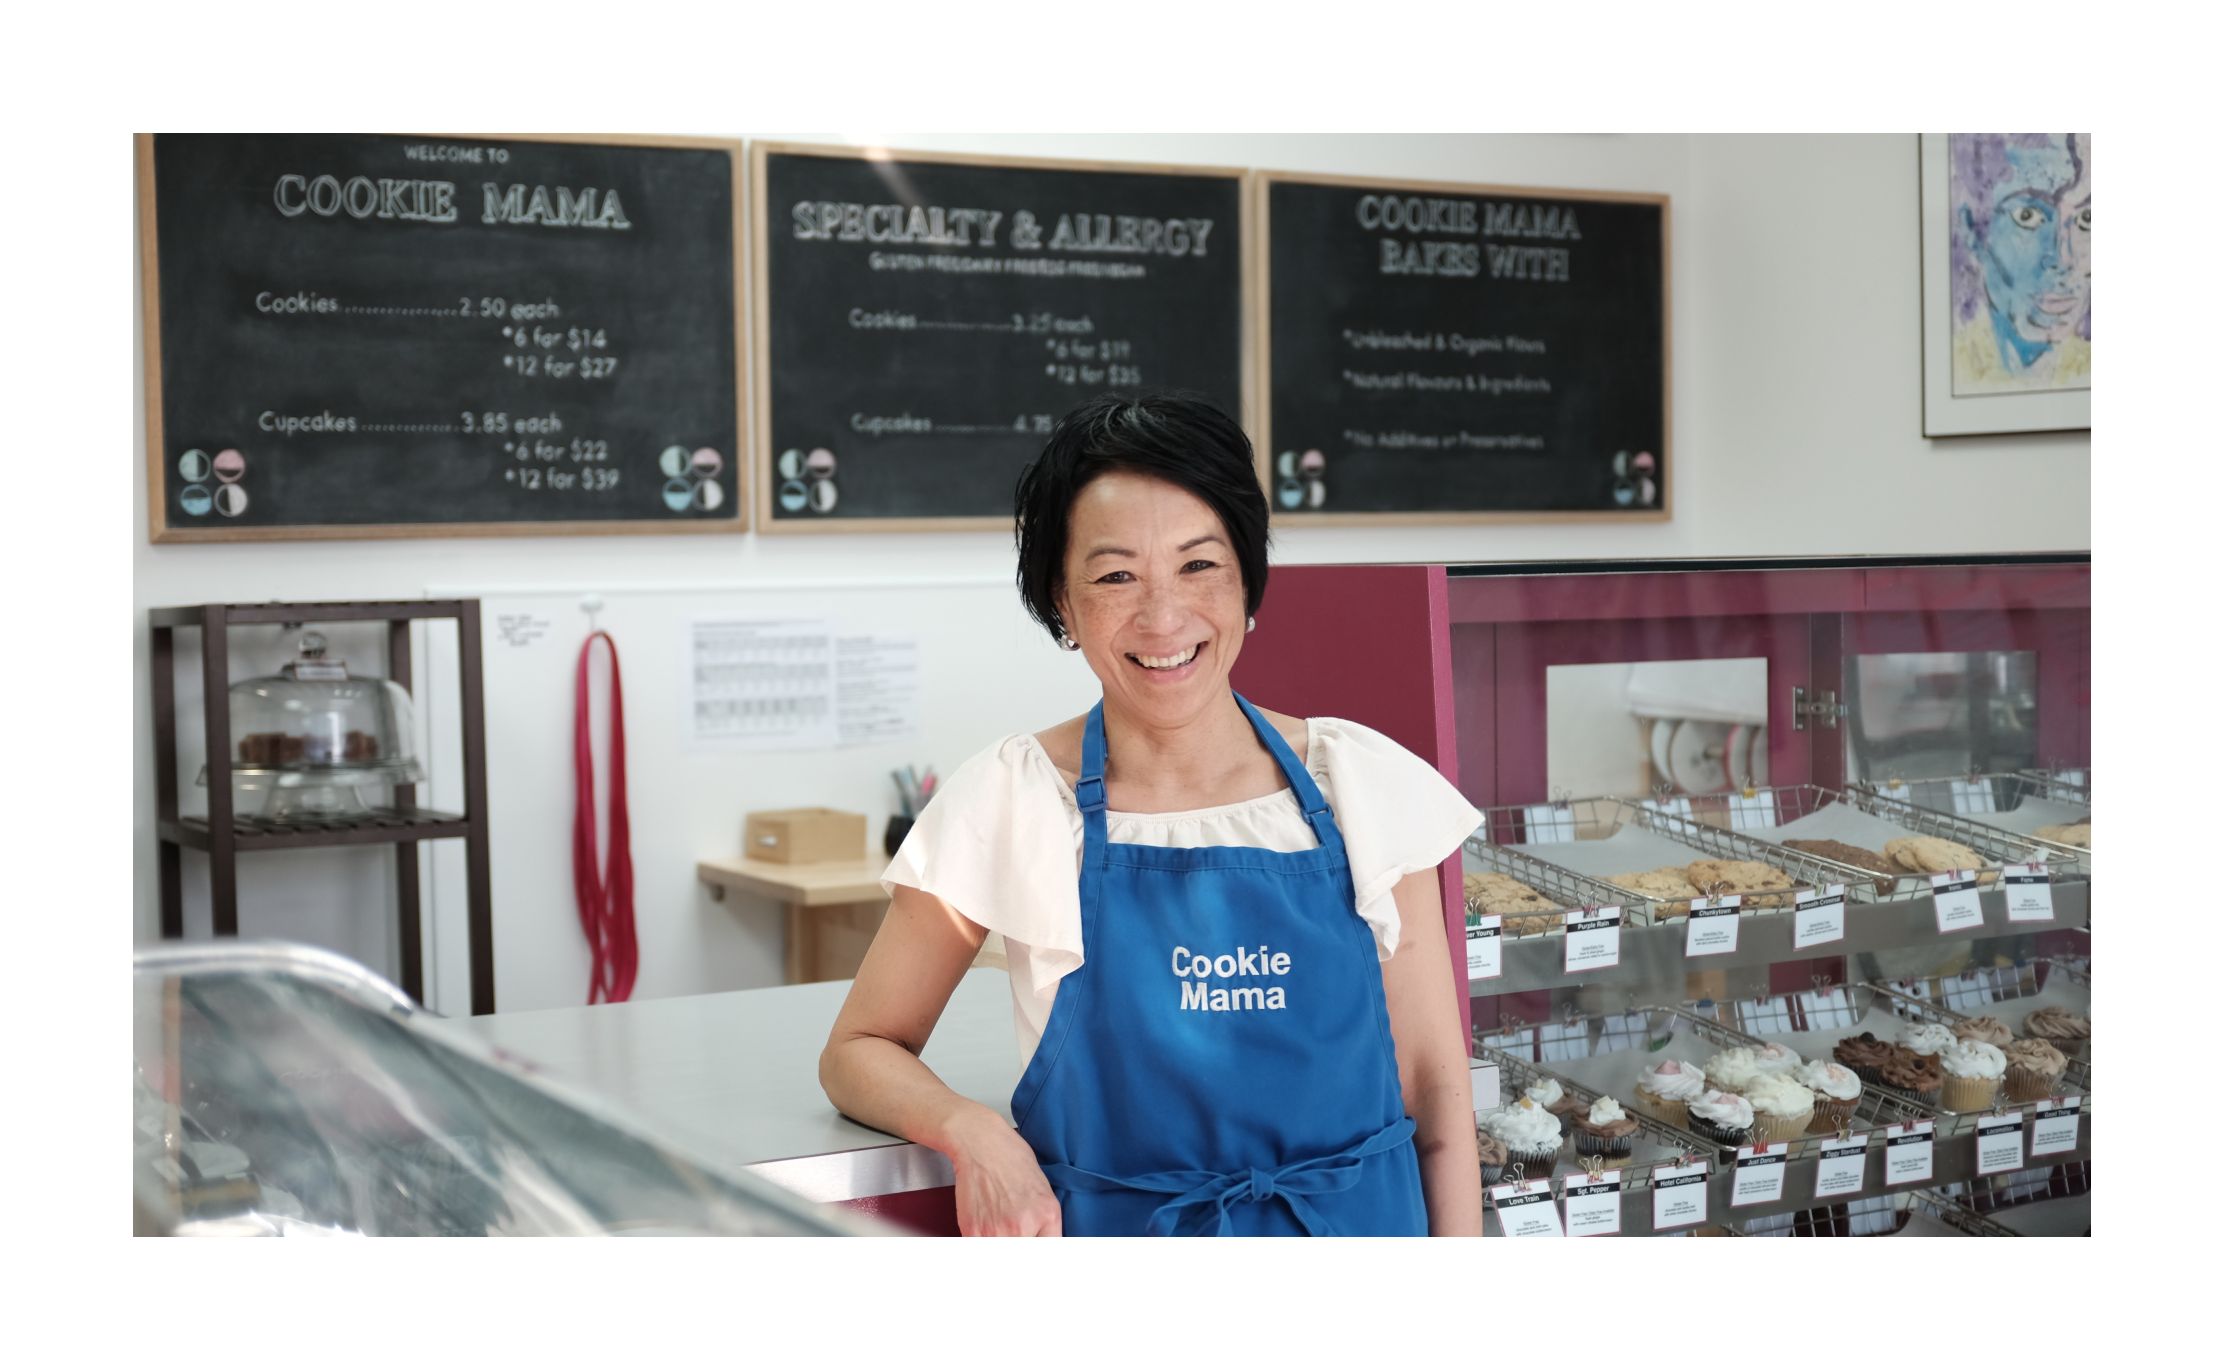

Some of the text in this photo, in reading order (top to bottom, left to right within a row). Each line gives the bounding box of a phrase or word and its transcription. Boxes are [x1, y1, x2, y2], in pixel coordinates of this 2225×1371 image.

[403, 144, 510, 164] WELCOME TO
[273, 174, 632, 229] COOKIE MAMA
[791, 200, 1215, 256] SPECIALTY & ALLERGY
[1355, 194, 1582, 240] COOKIE MAMA
[1379, 237, 1569, 281] BAKES WITH
[255, 291, 560, 320] Cookies 2.50 each
[848, 307, 917, 330] Cookies
[1053, 314, 1095, 334] each
[533, 326, 564, 349] for
[567, 327, 607, 352] $14
[1070, 337, 1096, 360] for
[1448, 332, 1503, 357] Organic
[544, 355, 575, 378] for
[578, 355, 618, 380] $27
[1079, 363, 1104, 386] for
[258, 410, 562, 436] Cupcakes 3.85 each
[850, 411, 933, 437] Cupcakes
[534, 440, 566, 461] for
[570, 439, 608, 463] $22
[546, 467, 577, 489] for
[581, 467, 620, 491] $39
[1698, 908, 1732, 917] Chunkytown
[1799, 896, 1841, 910] Smooth Criminal
[1476, 929, 1495, 937] Young
[1577, 920, 1610, 931] Purple Rain
[1172, 945, 1291, 978] Cookie
[1180, 981, 1287, 1011] Mama
[1897, 1136, 1923, 1145] Revolution
[1986, 1126, 2015, 1135] Locomotion
[1747, 1156, 1776, 1166] Just Dance
[1826, 1147, 1861, 1159] Ziggy Stardust
[1577, 1185, 1610, 1196] Sgt. Pepper
[1660, 1175, 1702, 1188] Hotel California
[1508, 1194, 1540, 1206] Love Train
